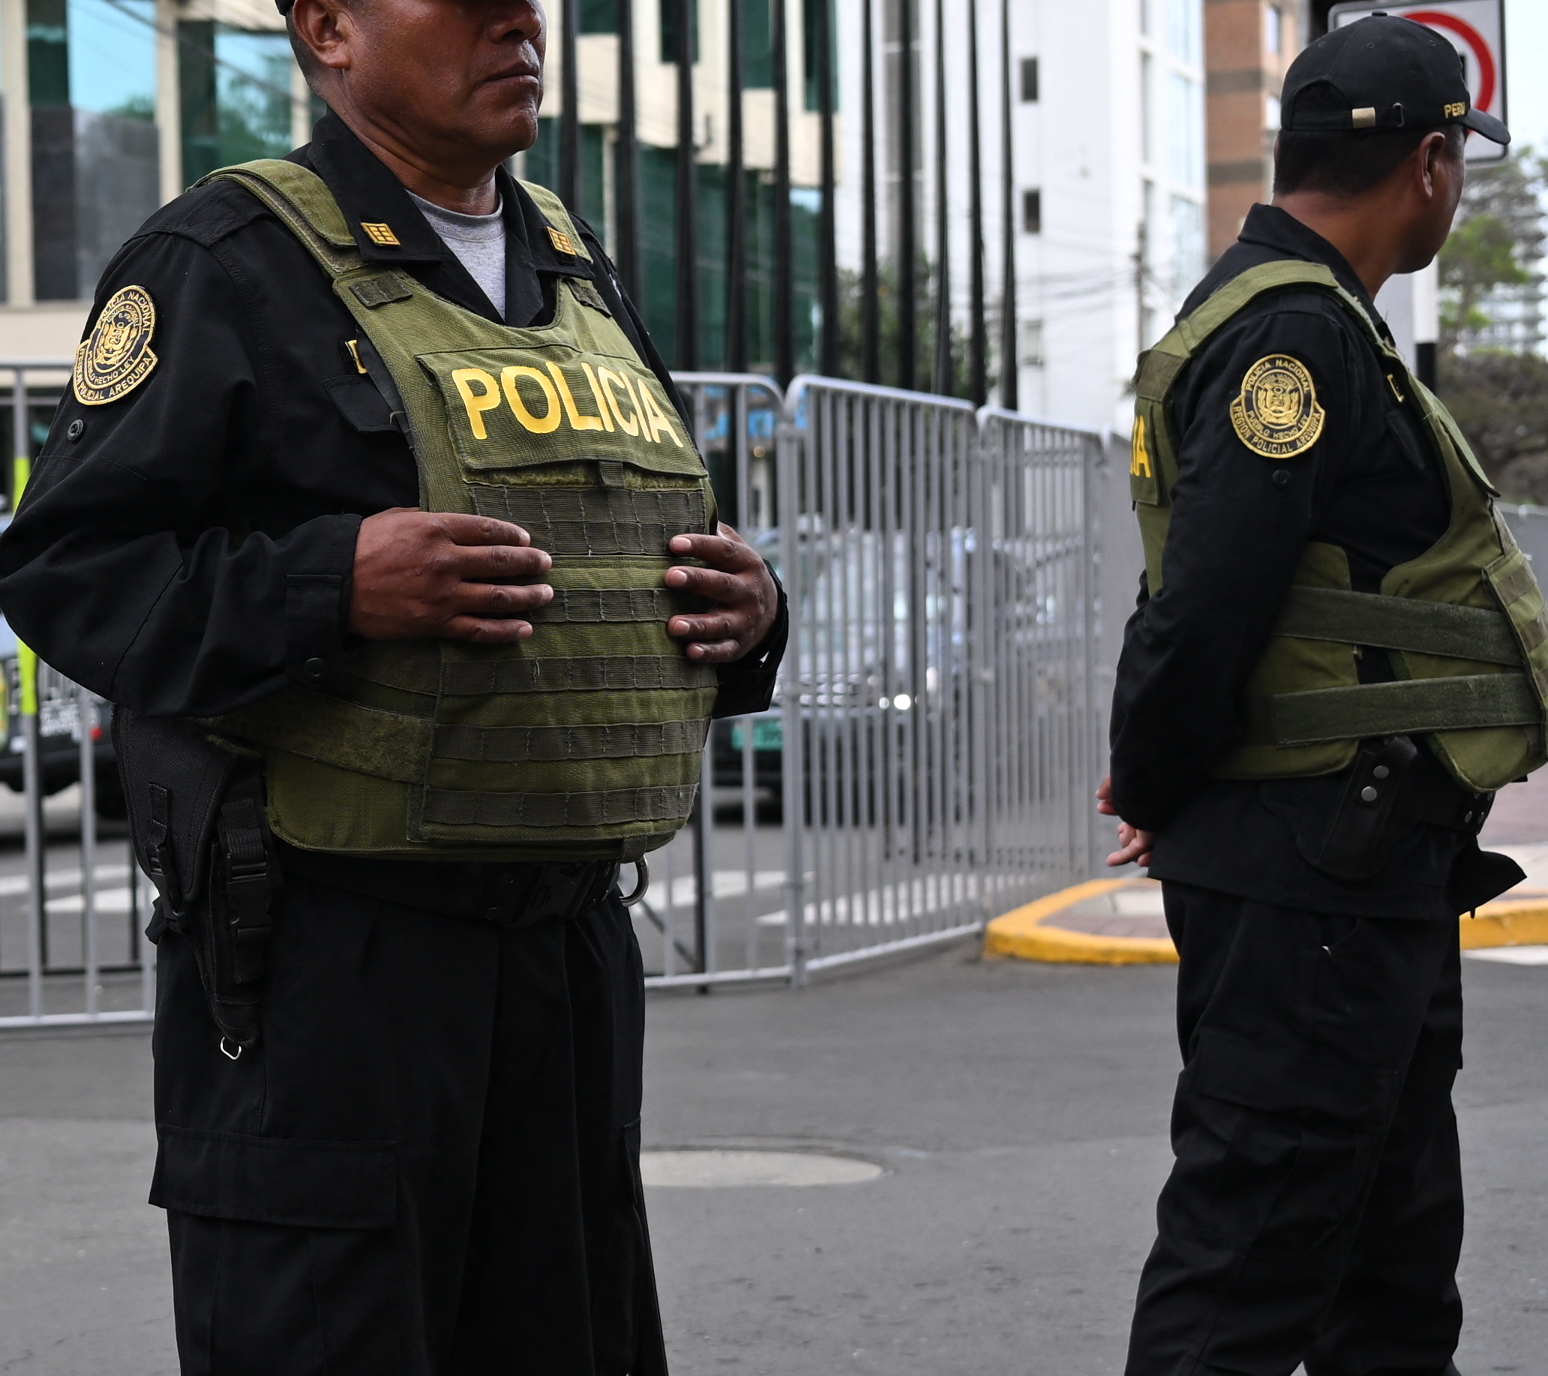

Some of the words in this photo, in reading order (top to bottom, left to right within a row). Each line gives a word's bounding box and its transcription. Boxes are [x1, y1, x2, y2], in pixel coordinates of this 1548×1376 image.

[108, 357, 152, 398] AREQUIPA
[1245, 362, 1272, 392] POLICIA
[1275, 359, 1311, 394] NACIONAL
[450, 361, 684, 448] POLICIA
[1250, 435, 1294, 454] POLICIAL
